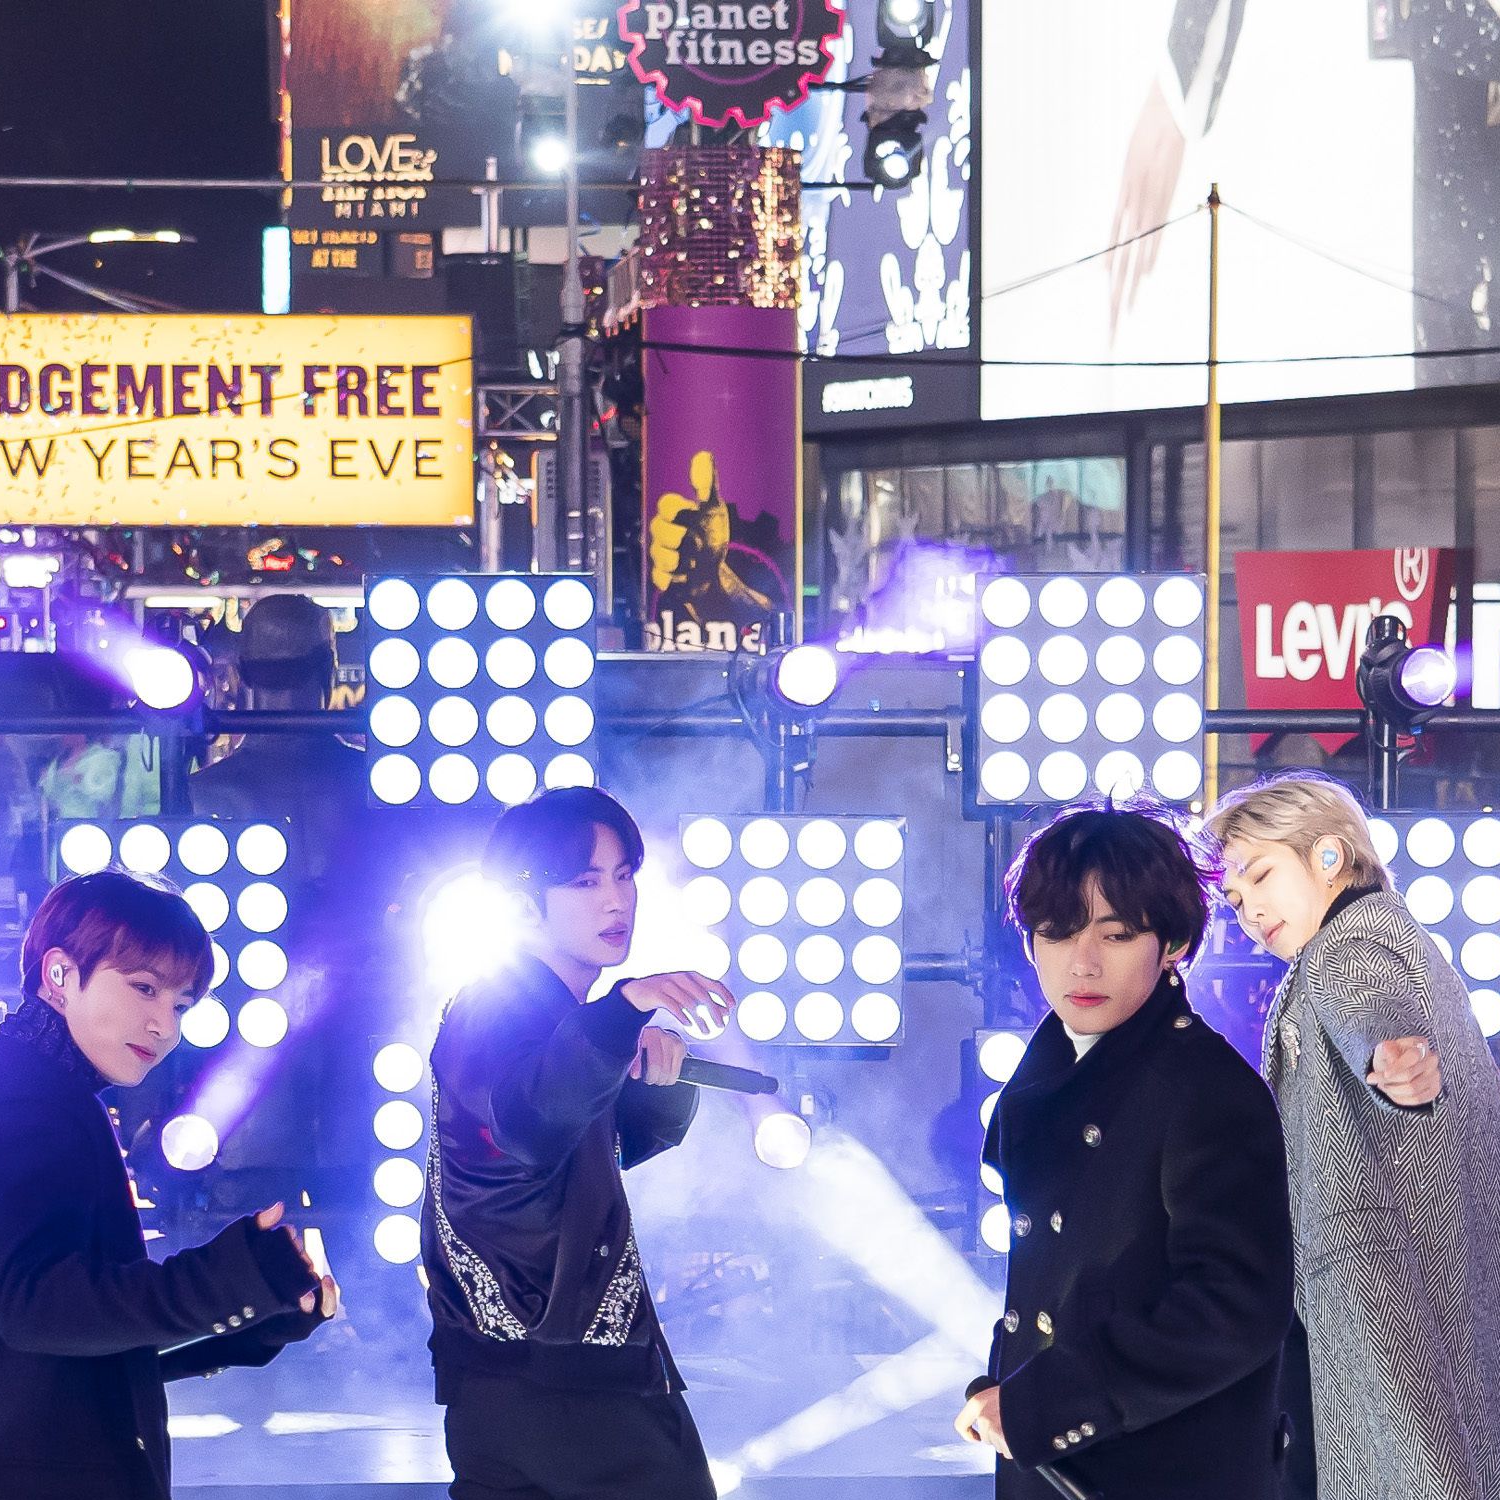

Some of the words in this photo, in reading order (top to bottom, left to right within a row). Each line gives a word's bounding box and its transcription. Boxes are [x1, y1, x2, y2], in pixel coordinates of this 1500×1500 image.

[645, 0, 790, 39] planet
[666, 30, 820, 66] fitness
[321, 133, 417, 173] LOVE
[301, 363, 442, 417] FREE
[83, 438, 300, 479] YEAR'S
[330, 438, 443, 478] EVE
[643, 611, 764, 652] plane
